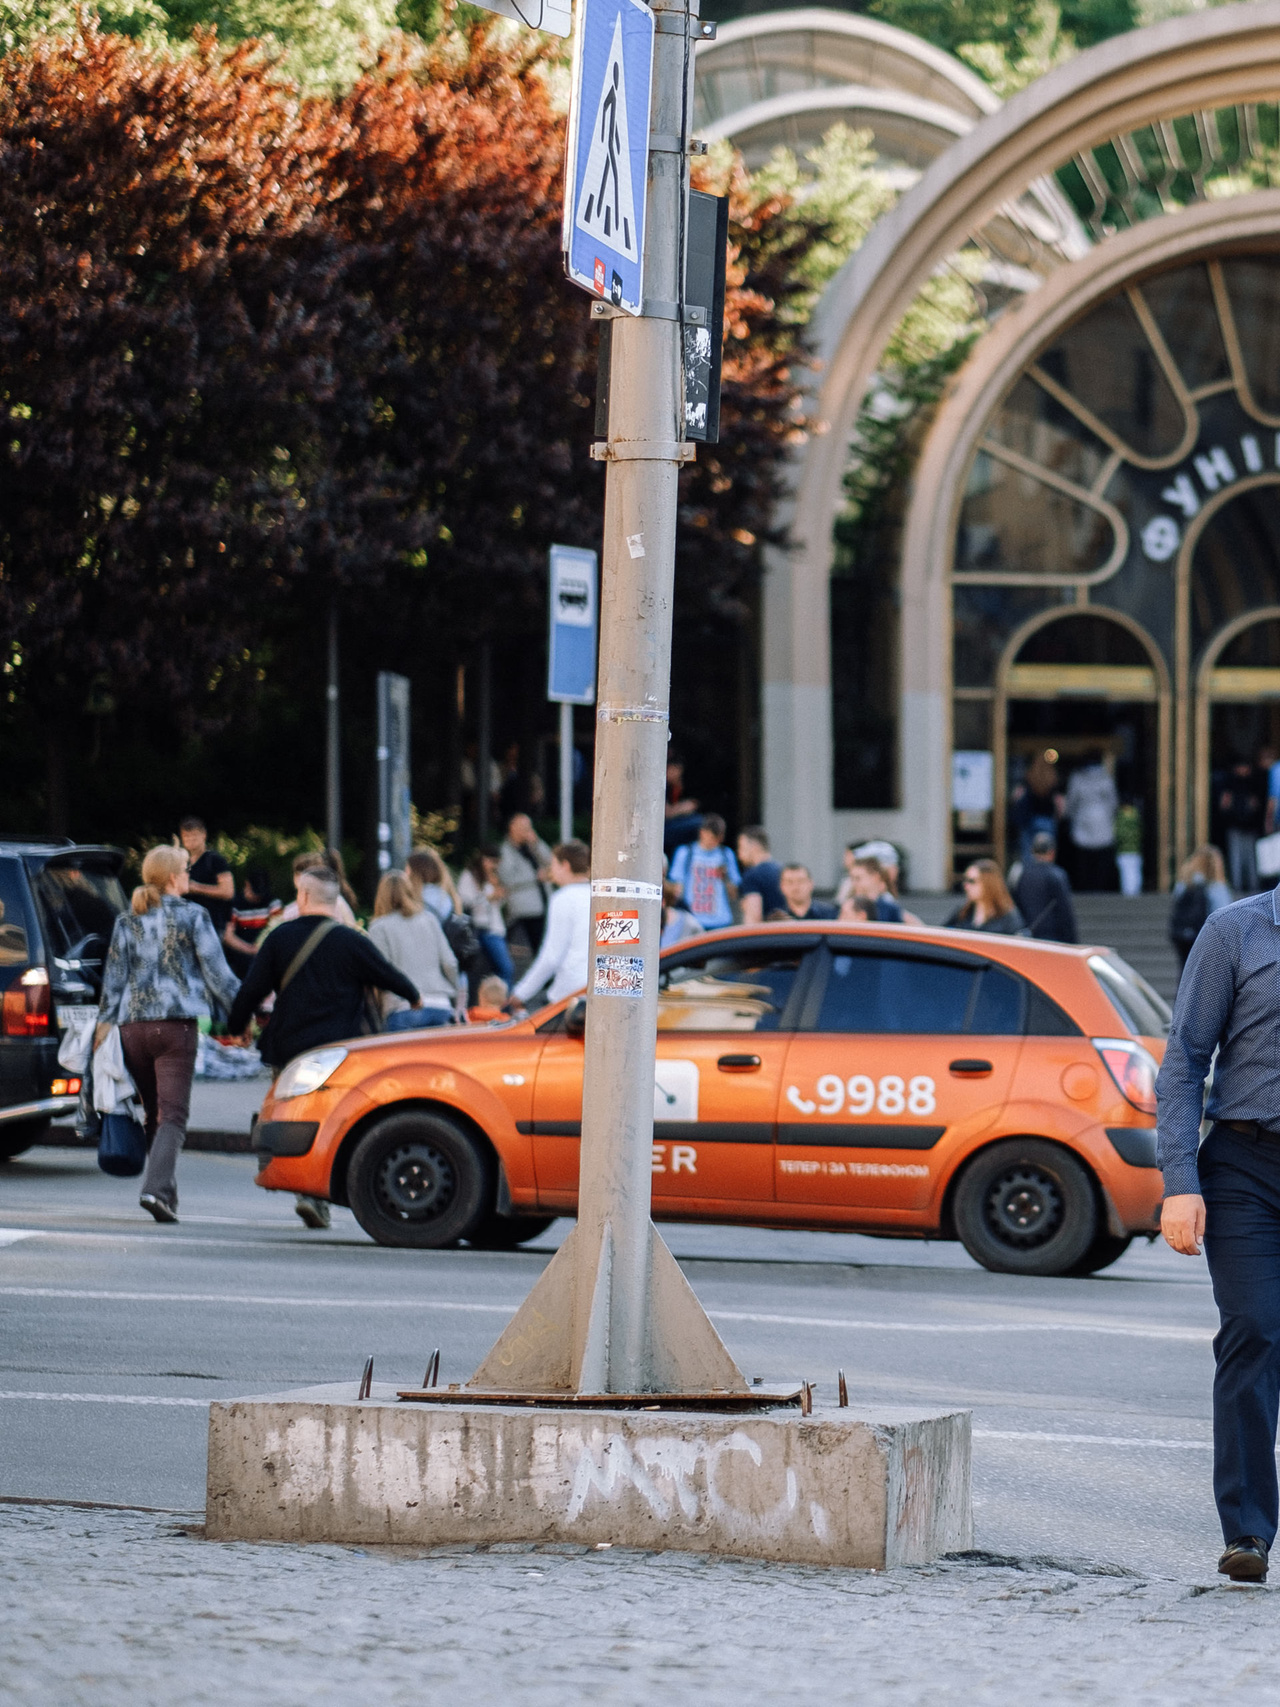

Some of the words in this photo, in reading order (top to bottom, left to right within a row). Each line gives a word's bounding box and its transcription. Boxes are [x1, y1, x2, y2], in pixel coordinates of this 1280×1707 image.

[817, 1074, 936, 1116] 9988
[779, 1159, 820, 1174] ТЕПЕР
[829, 1161, 847, 1175] ЗА
[848, 1162, 930, 1178] ТЕЛЕФОНОМ
